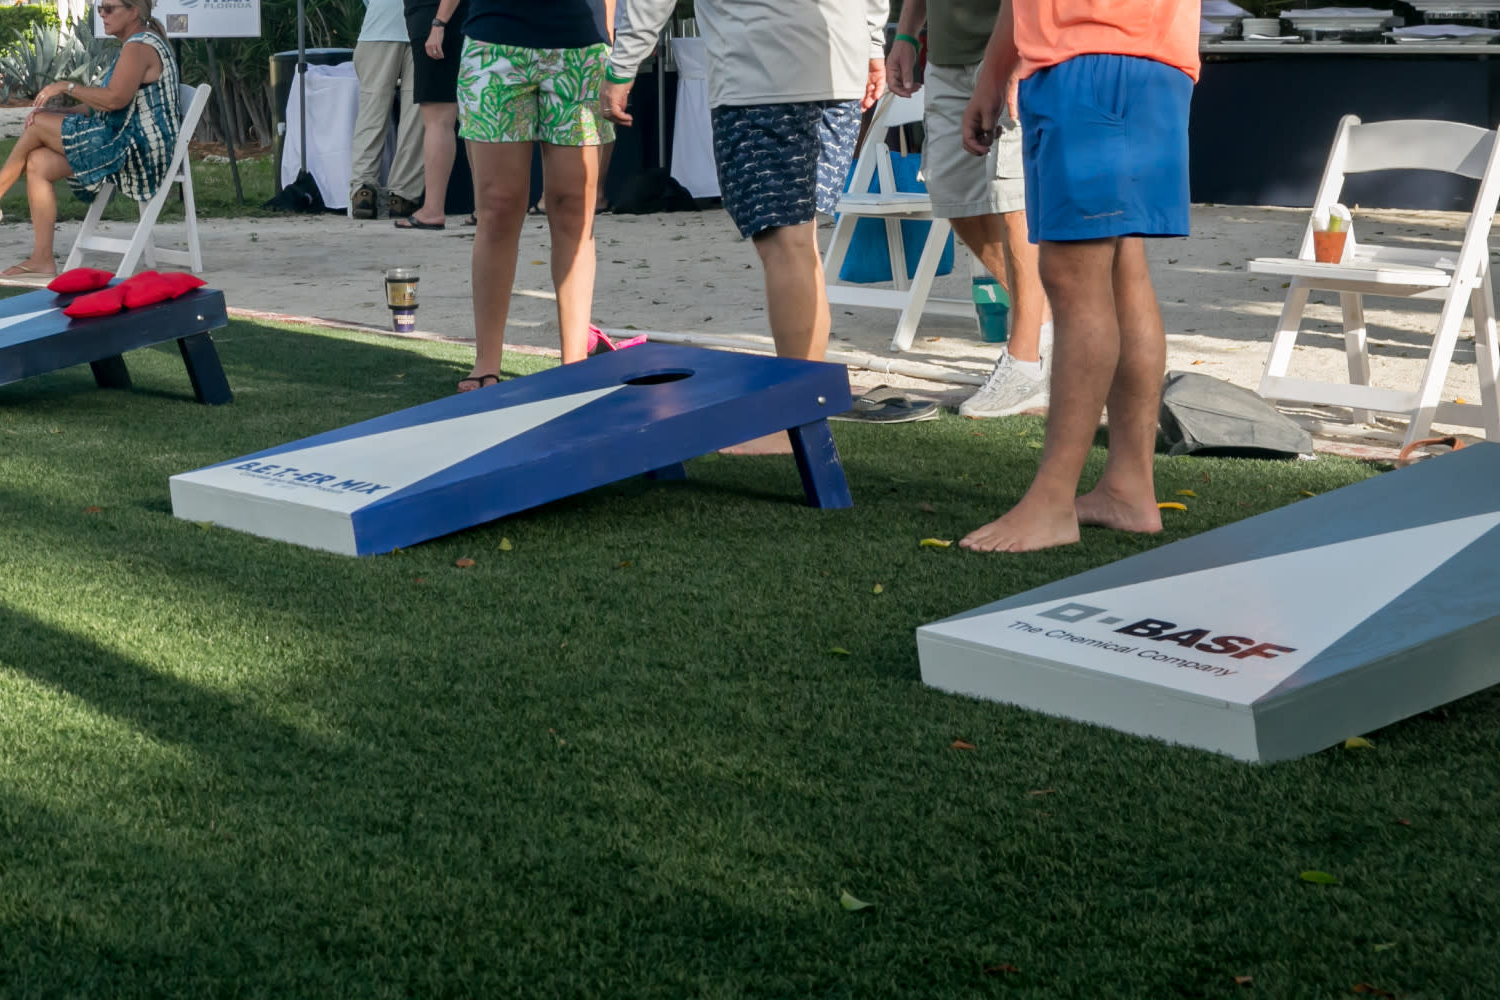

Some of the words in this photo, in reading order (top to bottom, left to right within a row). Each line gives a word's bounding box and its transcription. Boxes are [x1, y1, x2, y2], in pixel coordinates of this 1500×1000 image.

[330, 479, 392, 495] MIX
[1007, 620, 1044, 634] The
[1044, 629, 1136, 654] Chemical
[1137, 650, 1240, 678] Company
[1112, 618, 1298, 660] BASF
